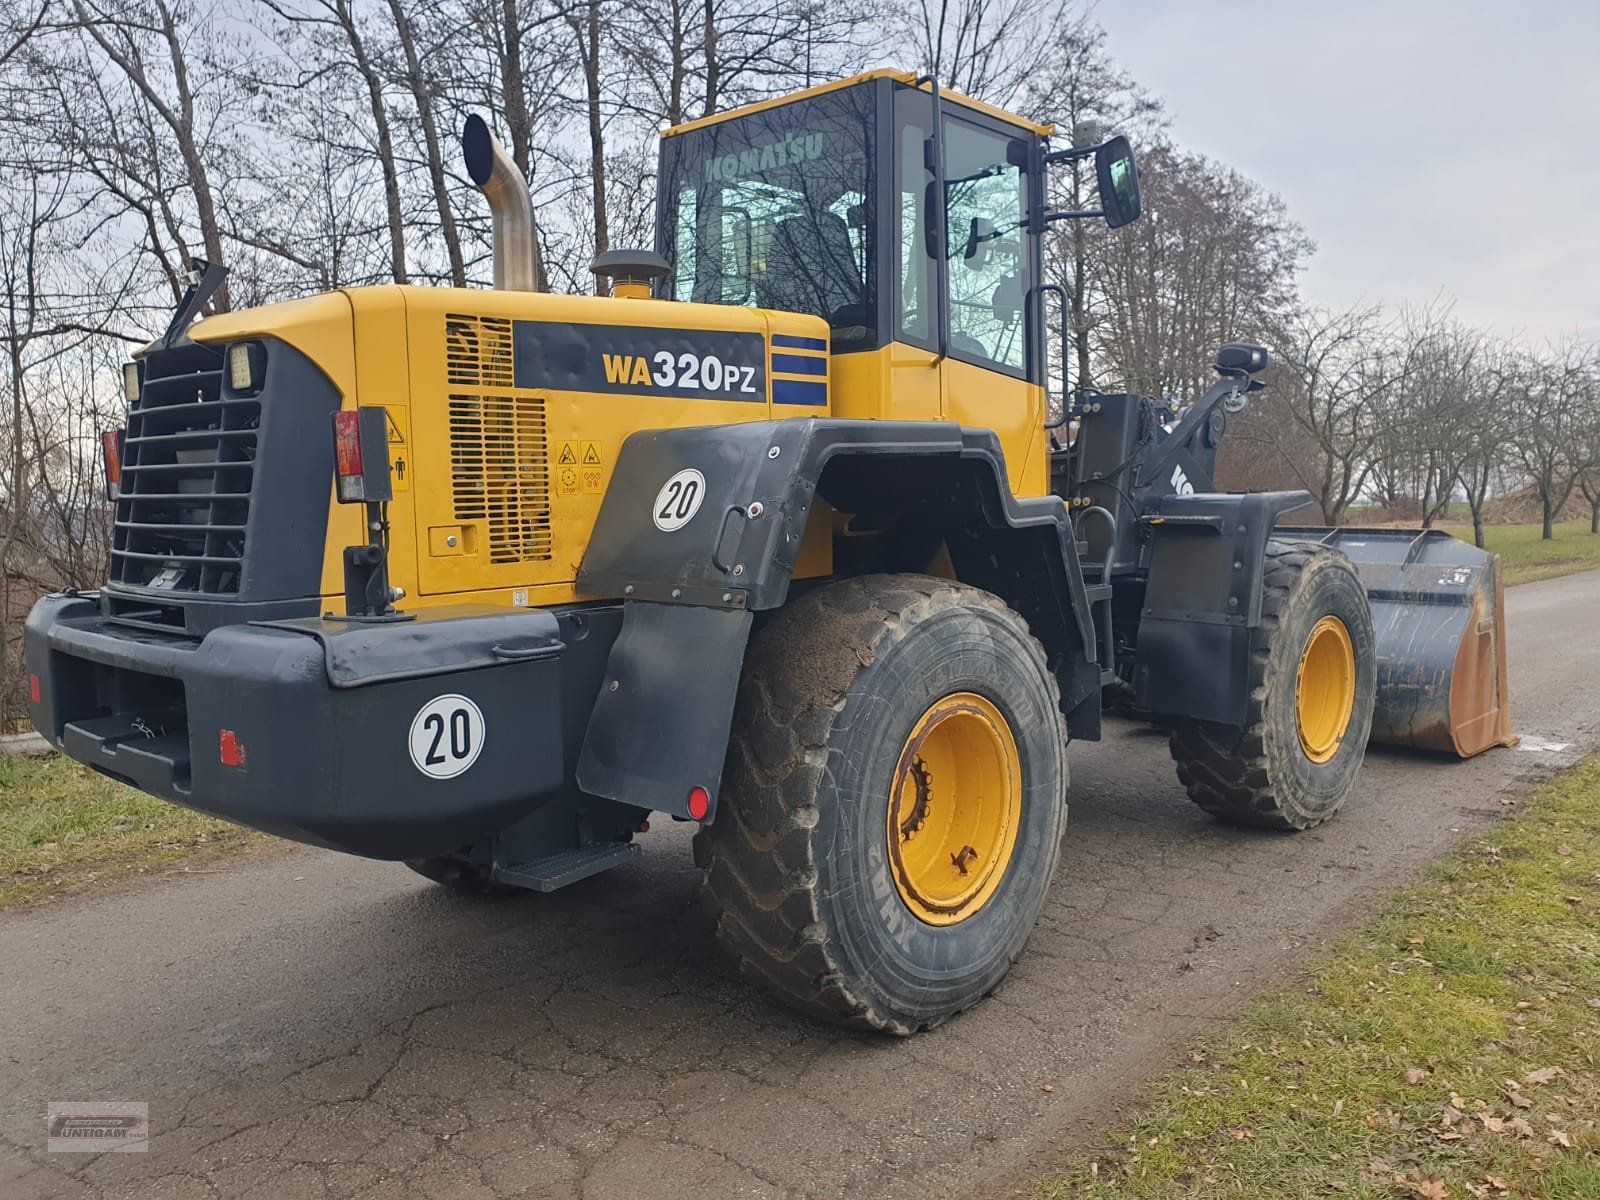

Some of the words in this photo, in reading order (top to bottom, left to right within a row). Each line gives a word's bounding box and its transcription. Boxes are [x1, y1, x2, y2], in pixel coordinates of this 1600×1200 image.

[705, 132, 823, 183] KOMATSU
[602, 351, 756, 393] WA320PZ
[659, 480, 698, 519] 20
[424, 708, 471, 767] 20
